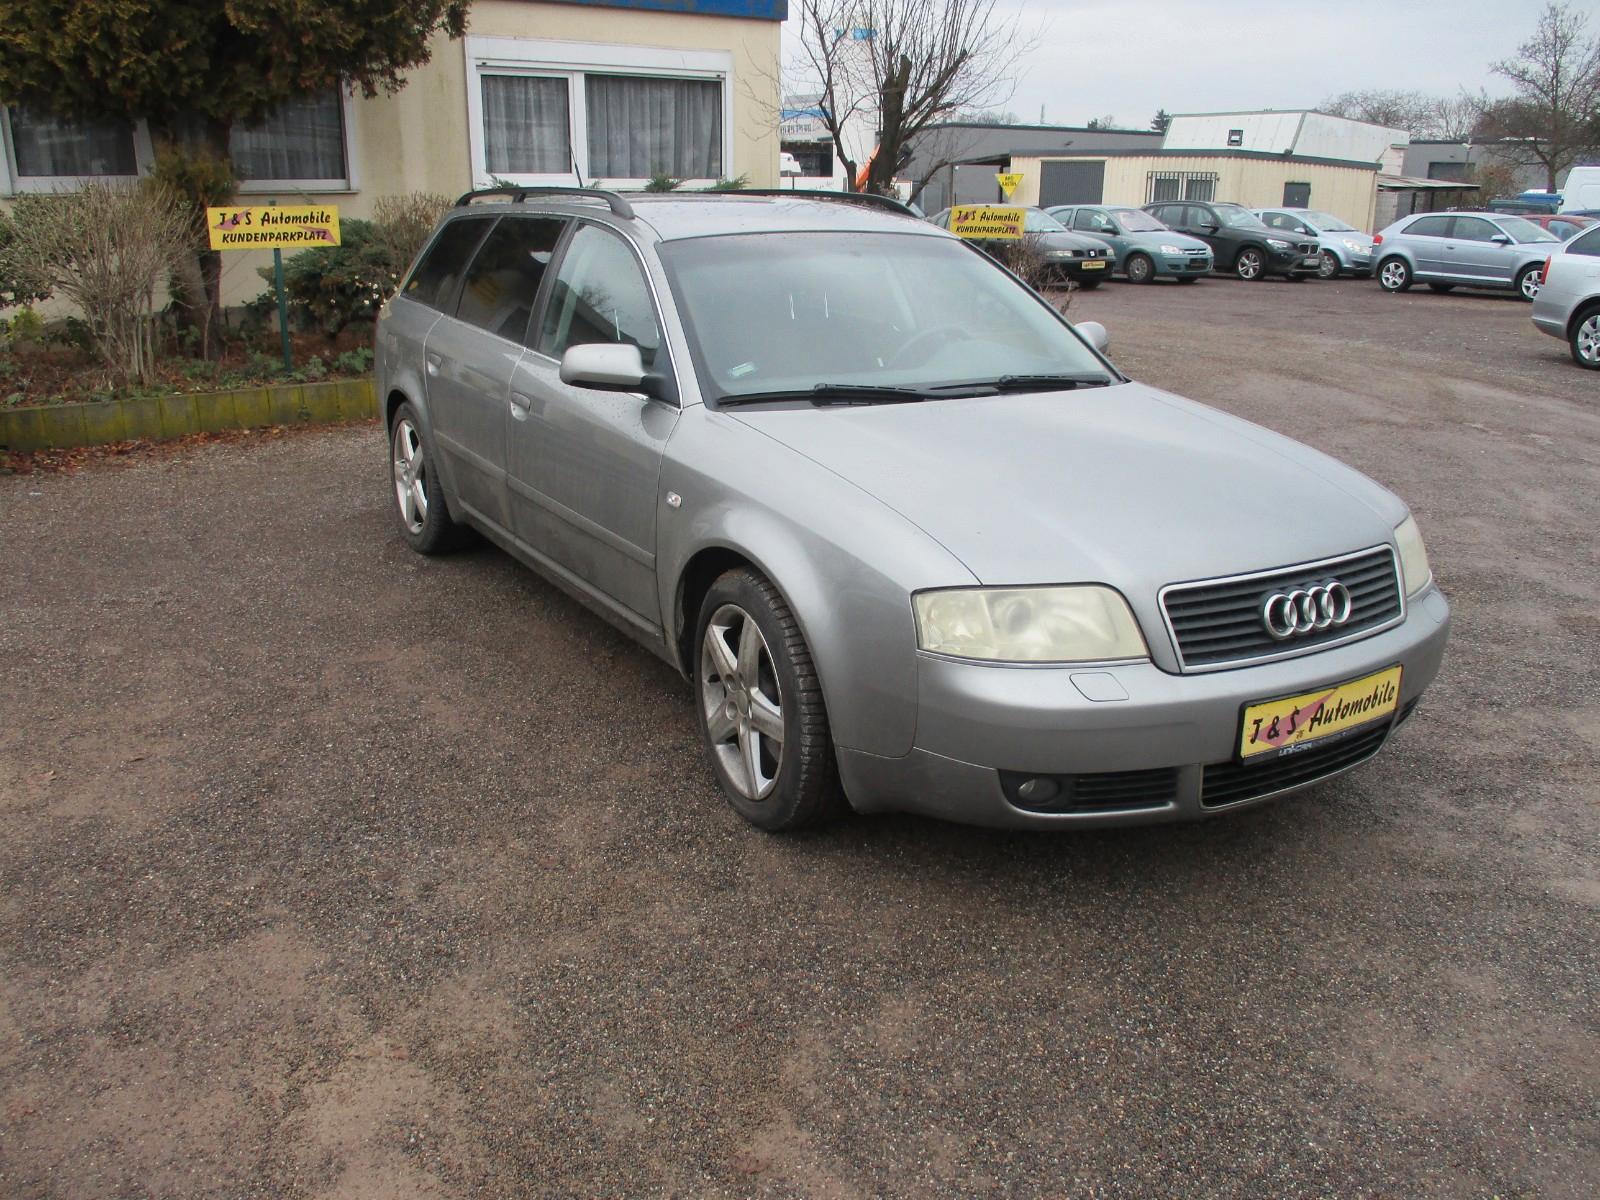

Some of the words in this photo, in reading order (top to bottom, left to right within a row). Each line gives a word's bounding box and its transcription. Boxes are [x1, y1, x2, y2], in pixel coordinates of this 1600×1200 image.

[231, 212, 240, 225] &
[245, 212, 252, 225] S
[261, 211, 331, 226] Automobile
[980, 210, 1020, 222] Automobile
[222, 230, 328, 243] KUNDENPARKPLATZ
[956, 225, 1016, 235] KUNDENPARKPLATZ
[1266, 716, 1280, 741] &
[1287, 705, 1300, 736] S
[1308, 680, 1395, 733] Automobile
